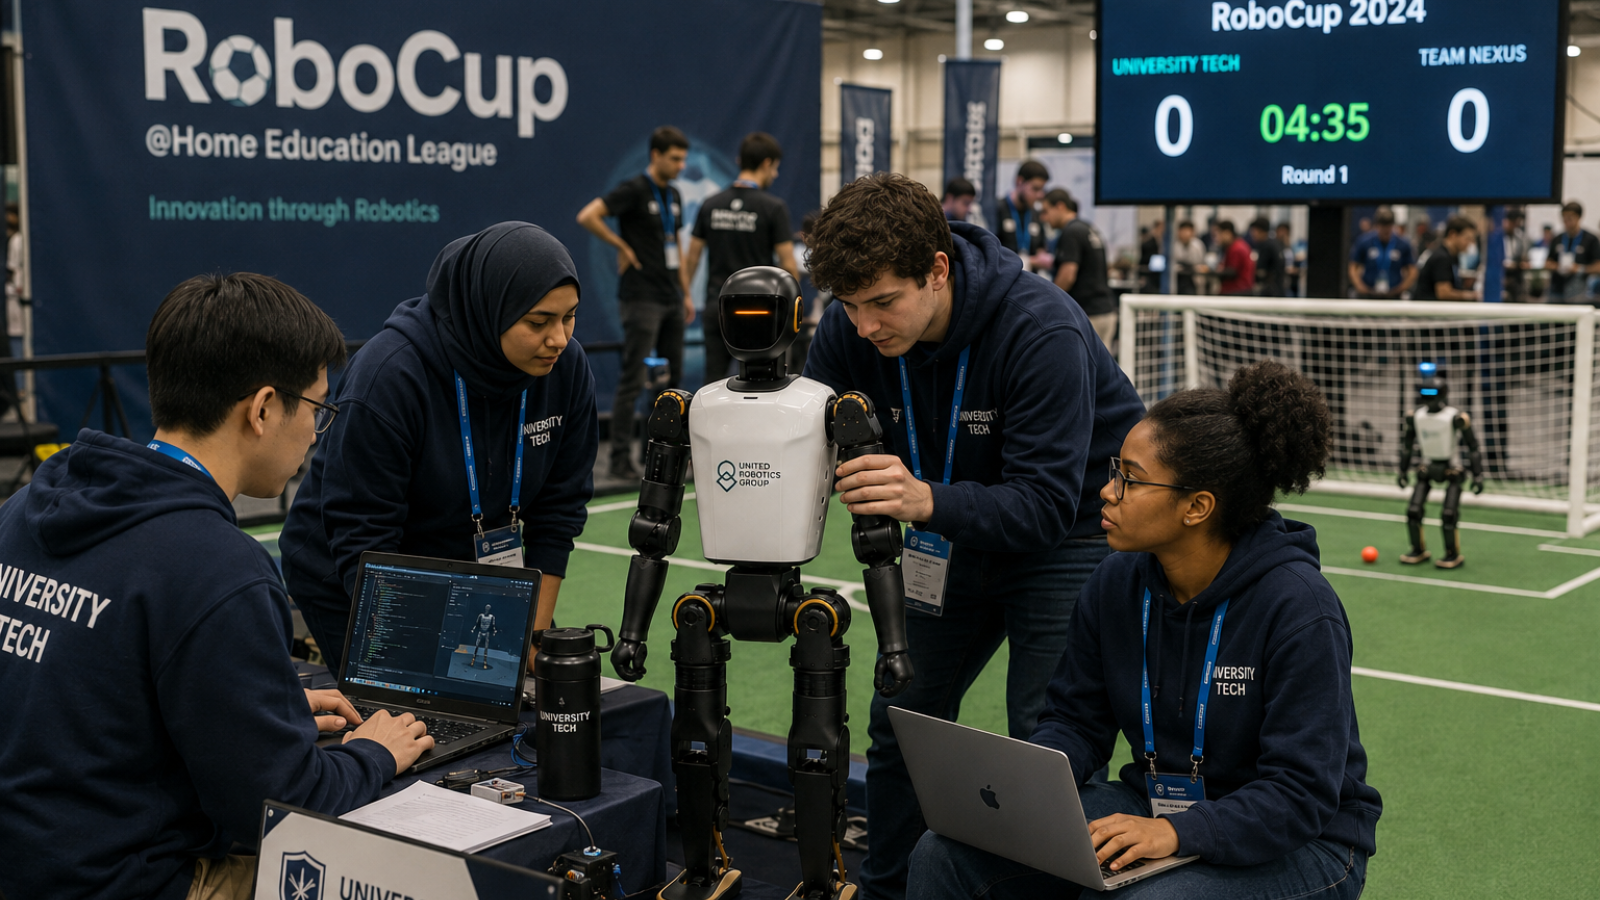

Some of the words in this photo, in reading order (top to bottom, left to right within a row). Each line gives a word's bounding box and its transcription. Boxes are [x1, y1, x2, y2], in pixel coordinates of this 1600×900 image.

[1211, 0, 1343, 34] RoboCup
[1349, 0, 1427, 26] 2024
[1112, 55, 1199, 76] UNIVERSITY
[1200, 53, 1240, 73] TECH
[1418, 46, 1466, 67] TEAM
[1468, 43, 1528, 64] NEXUS
[143, 7, 569, 138] RoboCup
[1154, 94, 1194, 158] 0
[1259, 102, 1370, 143] 04:35
[1447, 87, 1490, 154] 0
[145, 124, 258, 158] @Home
[264, 128, 401, 163] Education
[406, 133, 498, 172] League
[1281, 164, 1336, 185] Round
[1338, 164, 1349, 185] 1
[148, 194, 263, 221] Innovation
[268, 196, 351, 228] through
[354, 197, 440, 223] Robotics
[520, 415, 563, 435] NIVERSITY
[967, 424, 990, 435] TECH
[530, 431, 550, 447] TECH
[738, 462, 770, 470] UNITED
[738, 470, 781, 479] ROBOTICS
[738, 478, 770, 487] GROUP
[1216, 682, 1246, 696] TECH
[540, 710, 591, 723] UNIVERSITY
[552, 723, 577, 733] TECH
